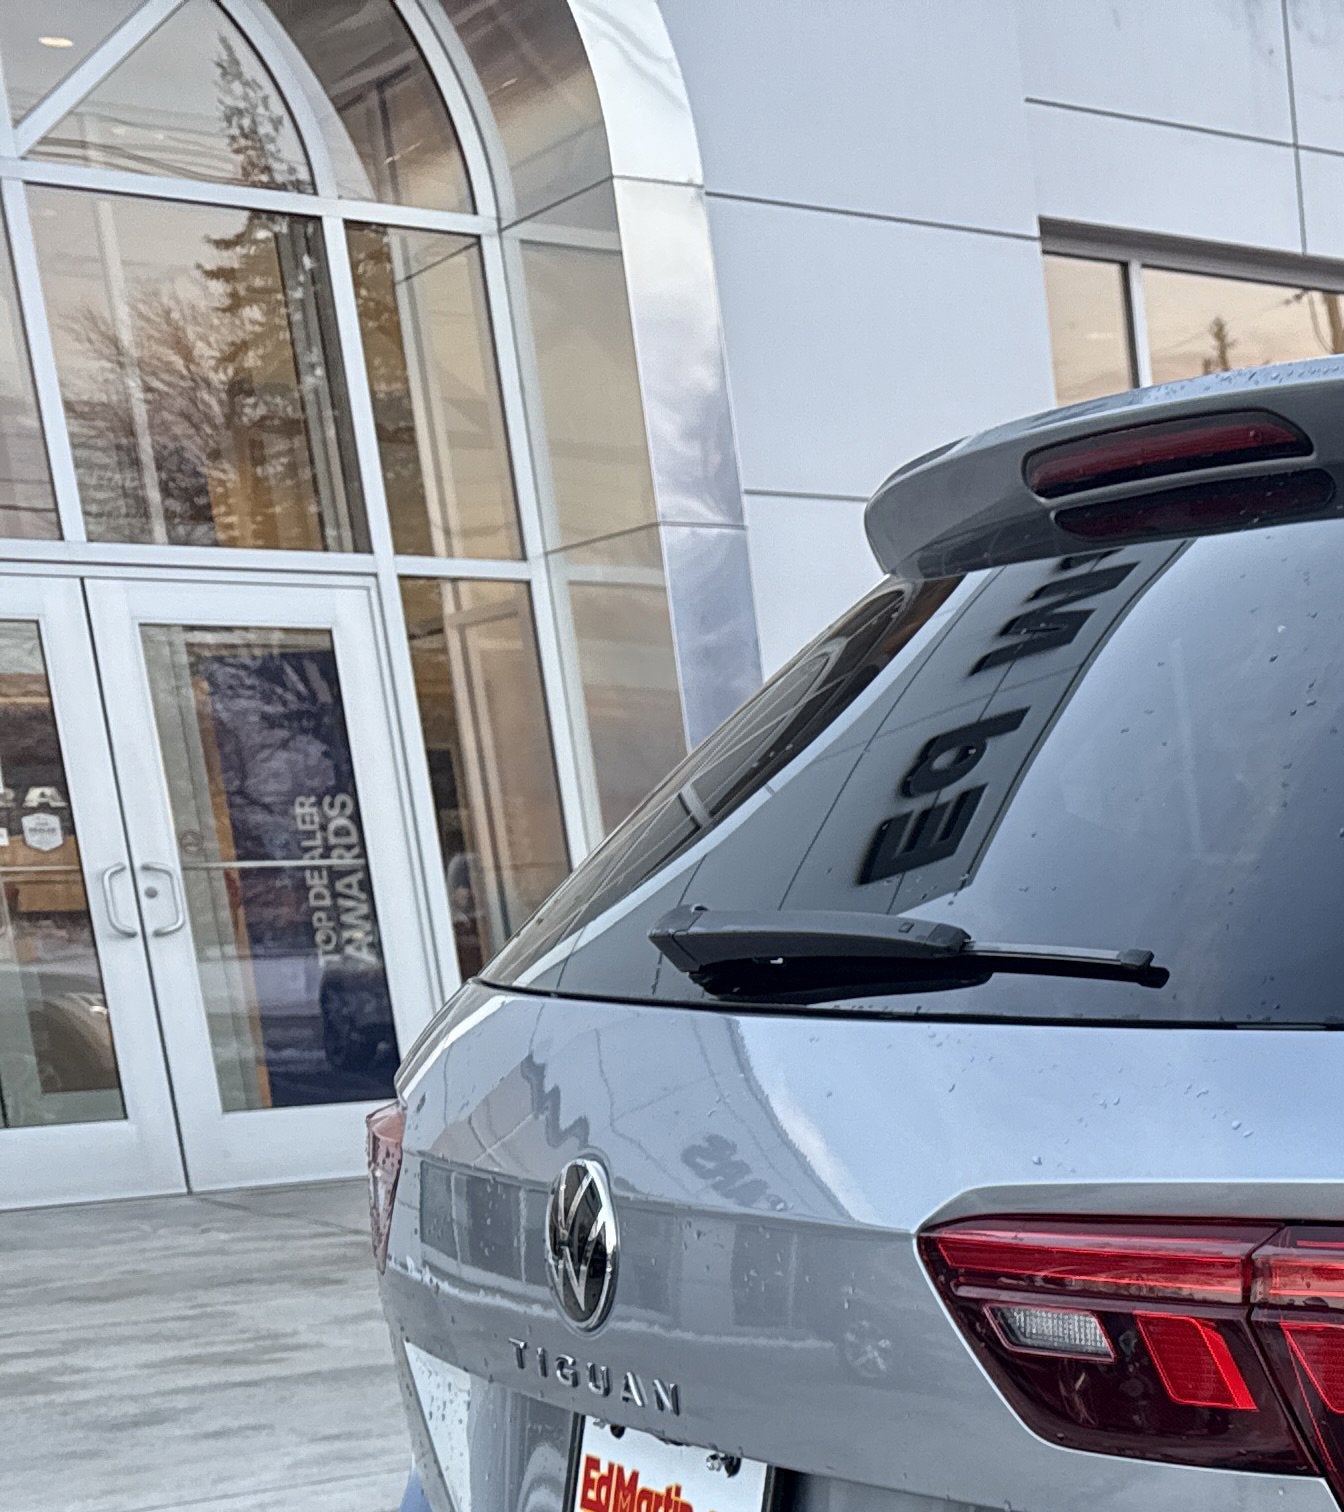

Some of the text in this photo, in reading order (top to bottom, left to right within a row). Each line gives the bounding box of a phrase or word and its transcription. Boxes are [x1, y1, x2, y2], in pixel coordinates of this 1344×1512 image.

[294, 795, 341, 968] TOP DEALER
[322, 792, 379, 967] AWARDS
[508, 1338, 681, 1416] TIGUAN
